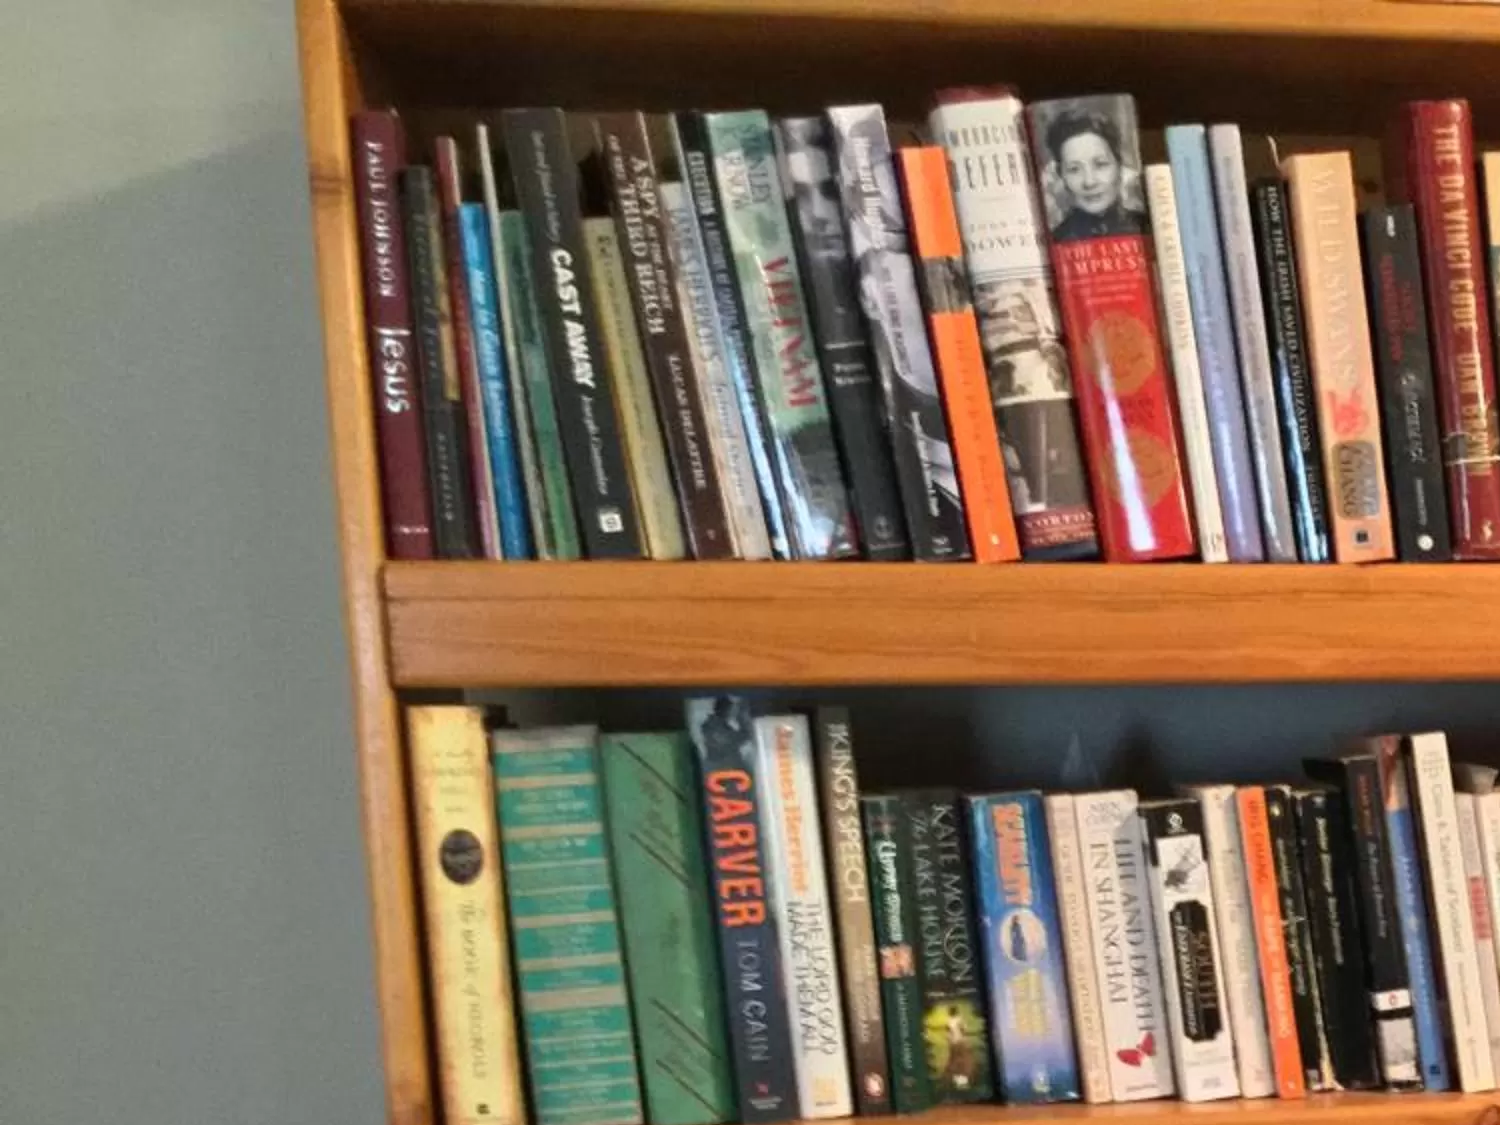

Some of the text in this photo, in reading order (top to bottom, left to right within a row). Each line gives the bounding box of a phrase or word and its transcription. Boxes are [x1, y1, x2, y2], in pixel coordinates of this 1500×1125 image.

[365, 141, 397, 297] PAUL JOHNSON
[630, 157, 658, 218] A SPY
[851, 136, 881, 193] Howard
[1433, 124, 1478, 333] THE DA VINCI CODE
[550, 249, 595, 389] CAST AWAY
[616, 183, 665, 334] THIRD REICH
[762, 255, 819, 408] VIETNAM
[1062, 253, 1146, 275] EMPRESS
[1265, 186, 1312, 452] HOW THE IRISH SAVED CIVILIZATION
[1309, 169, 1359, 384] WILD SWANS
[374, 327, 411, 413] Jesus
[668, 355, 690, 403] LUCAS
[1456, 353, 1494, 477] DAN BROWN
[1336, 443, 1359, 516] CHANG
[705, 769, 767, 928] CARVER
[775, 727, 809, 894] James Herriot
[830, 731, 867, 901] KING'S SPEECH
[1249, 832, 1269, 885] CHANG
[787, 900, 809, 952] MADE
[913, 844, 944, 979] LAKE HOUSE
[931, 804, 975, 982] KATE MORTON
[1090, 841, 1129, 1006] IN SHANGHAI
[1112, 838, 1156, 1033] LIFE AND DEATH
[736, 940, 771, 1061] TOM CAIN
[806, 902, 838, 1054] THE LORD GOD
